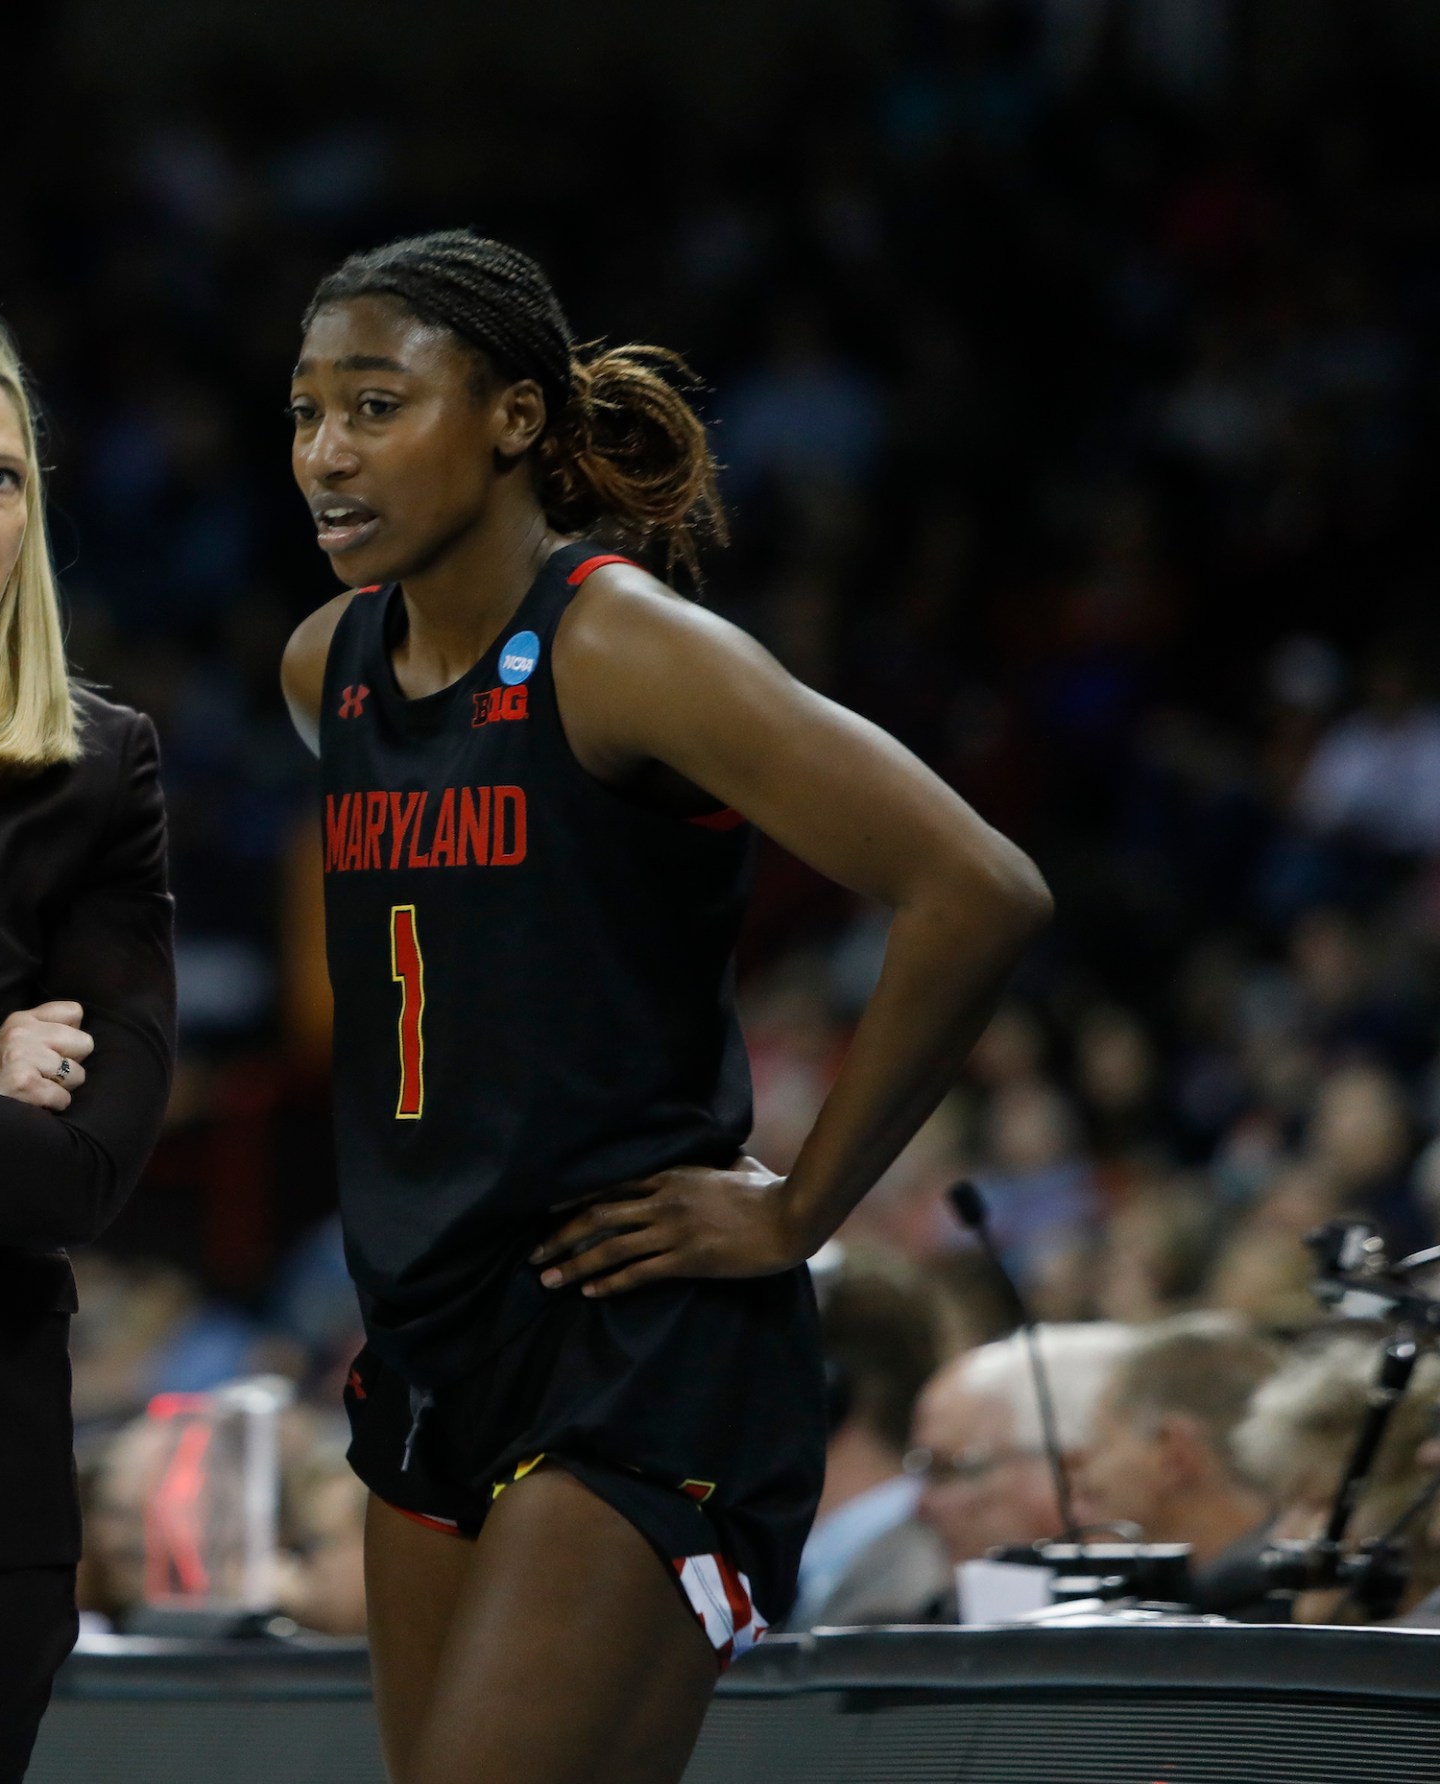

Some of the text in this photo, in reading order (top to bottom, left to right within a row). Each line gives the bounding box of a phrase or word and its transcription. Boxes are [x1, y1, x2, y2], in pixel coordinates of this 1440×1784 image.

[503, 655, 534, 672] NCAA
[325, 785, 528, 872] MARYLAND
[390, 904, 425, 1120] 1
